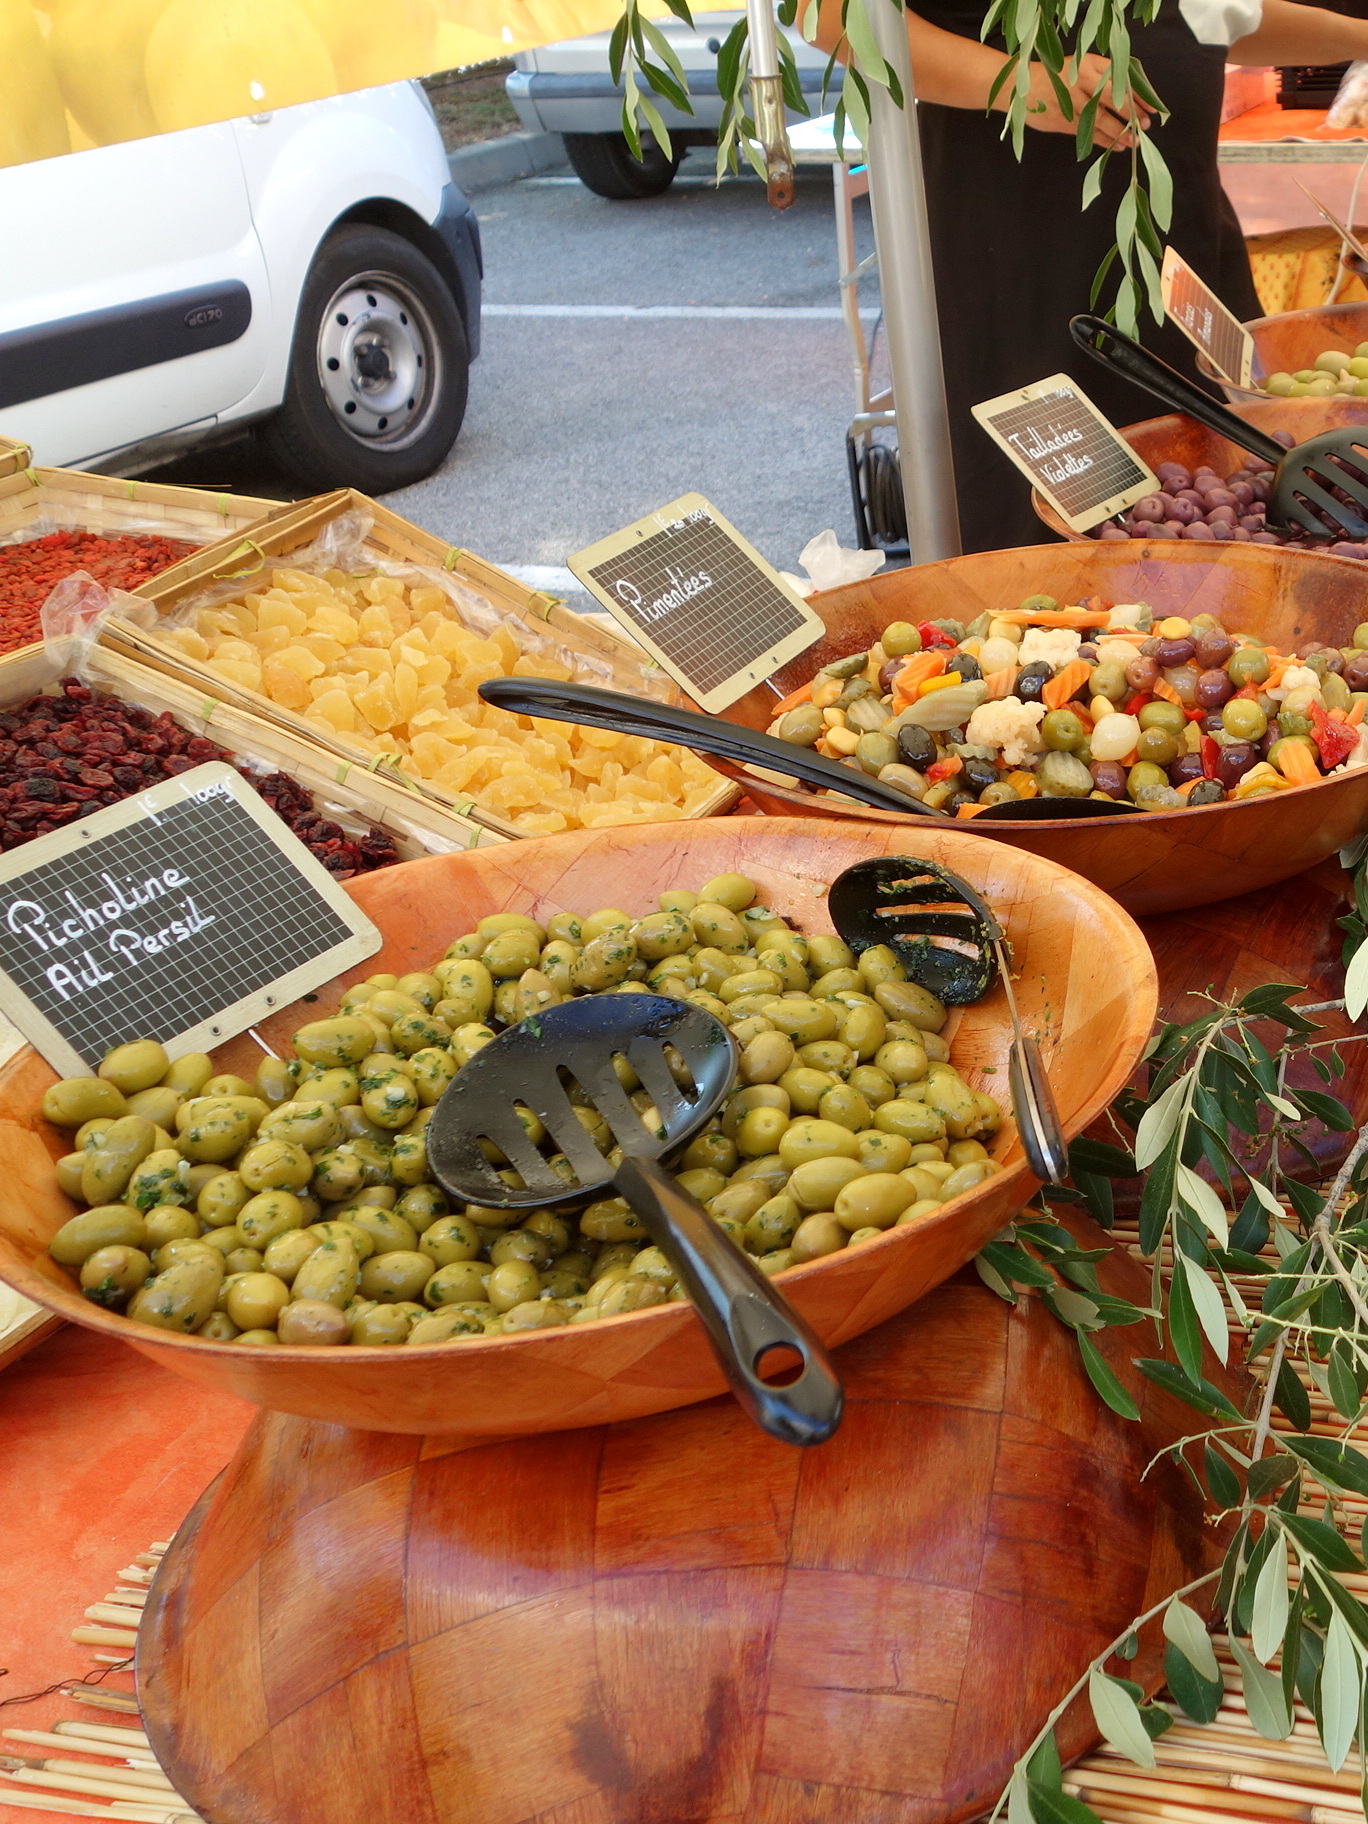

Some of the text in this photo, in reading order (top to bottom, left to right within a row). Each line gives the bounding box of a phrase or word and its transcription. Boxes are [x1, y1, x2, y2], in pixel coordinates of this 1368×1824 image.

[1008, 423, 1083, 460] Tailladées
[1040, 452, 1094, 485] Violettes
[616, 567, 713, 623] Pimentées
[7, 868, 190, 951] Picholine
[46, 896, 215, 1001] Ail Persil
